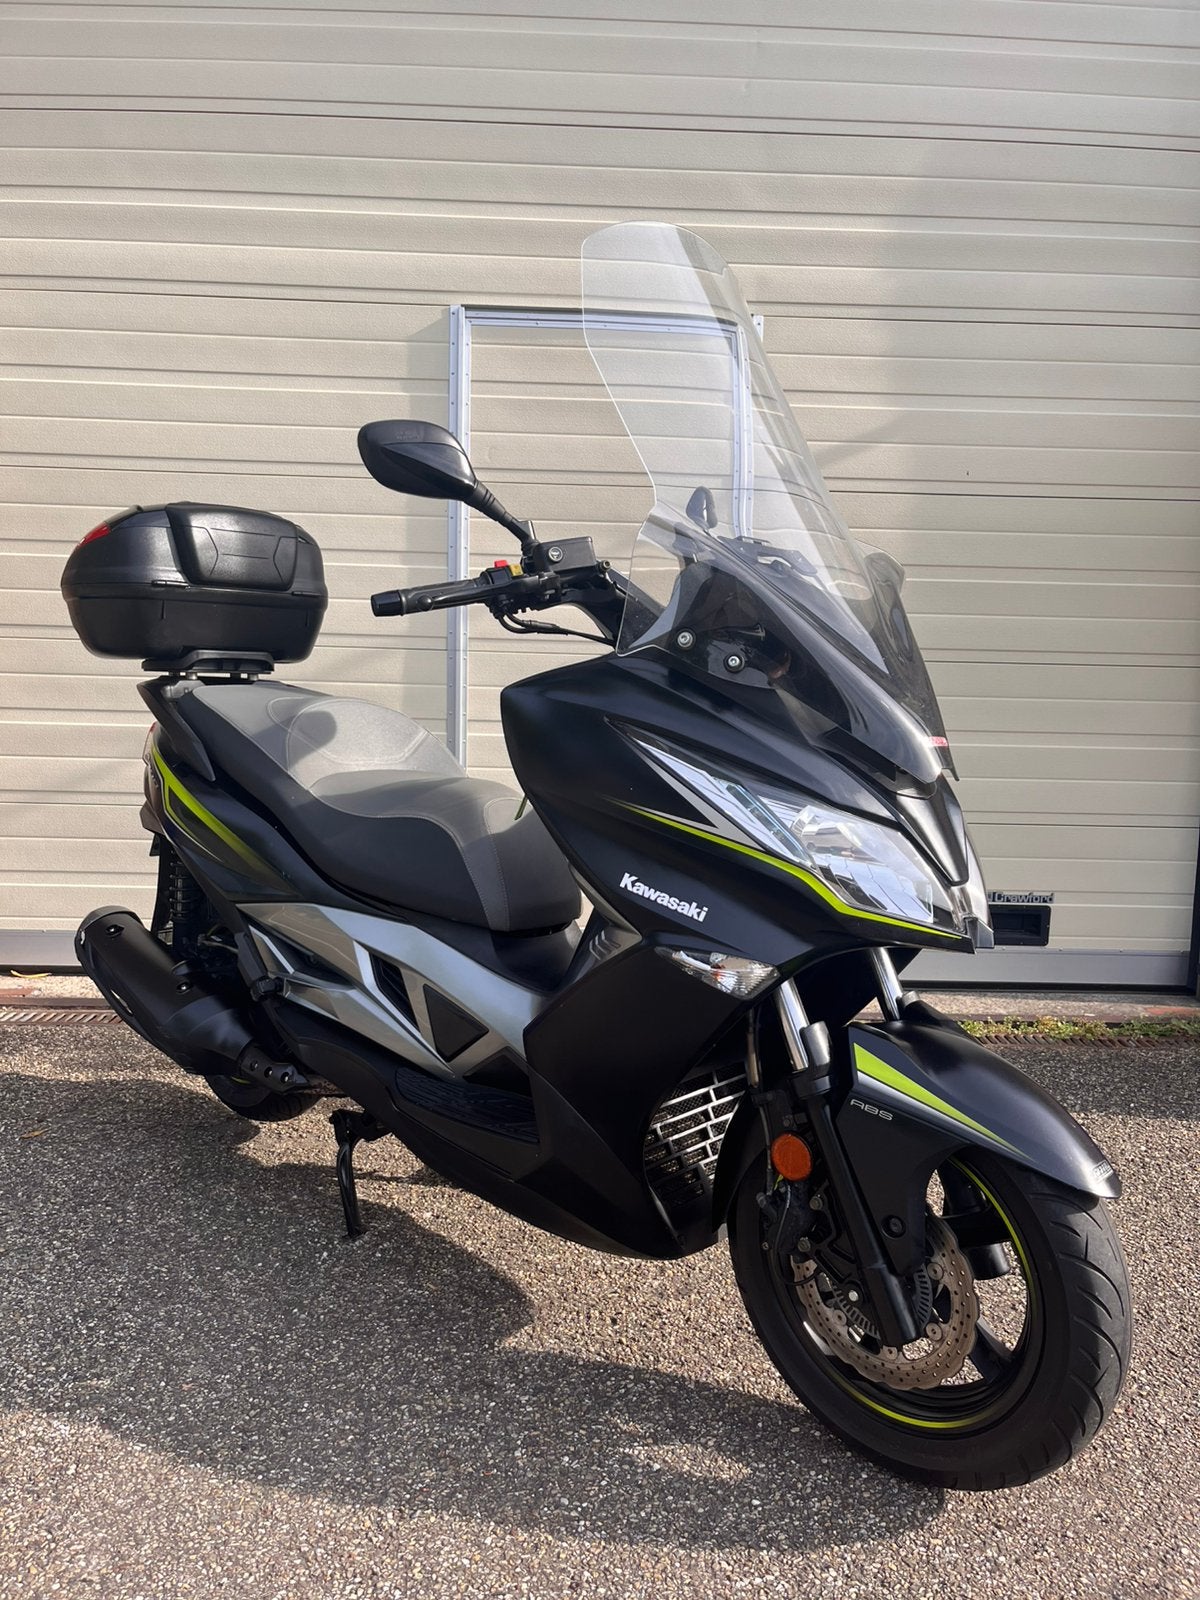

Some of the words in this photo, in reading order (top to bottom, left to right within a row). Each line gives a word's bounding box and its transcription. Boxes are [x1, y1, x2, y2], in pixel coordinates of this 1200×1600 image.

[620, 872, 708, 922] Kawasaki
[995, 892, 1054, 904] Crawford
[851, 1099, 893, 1120] ABS
